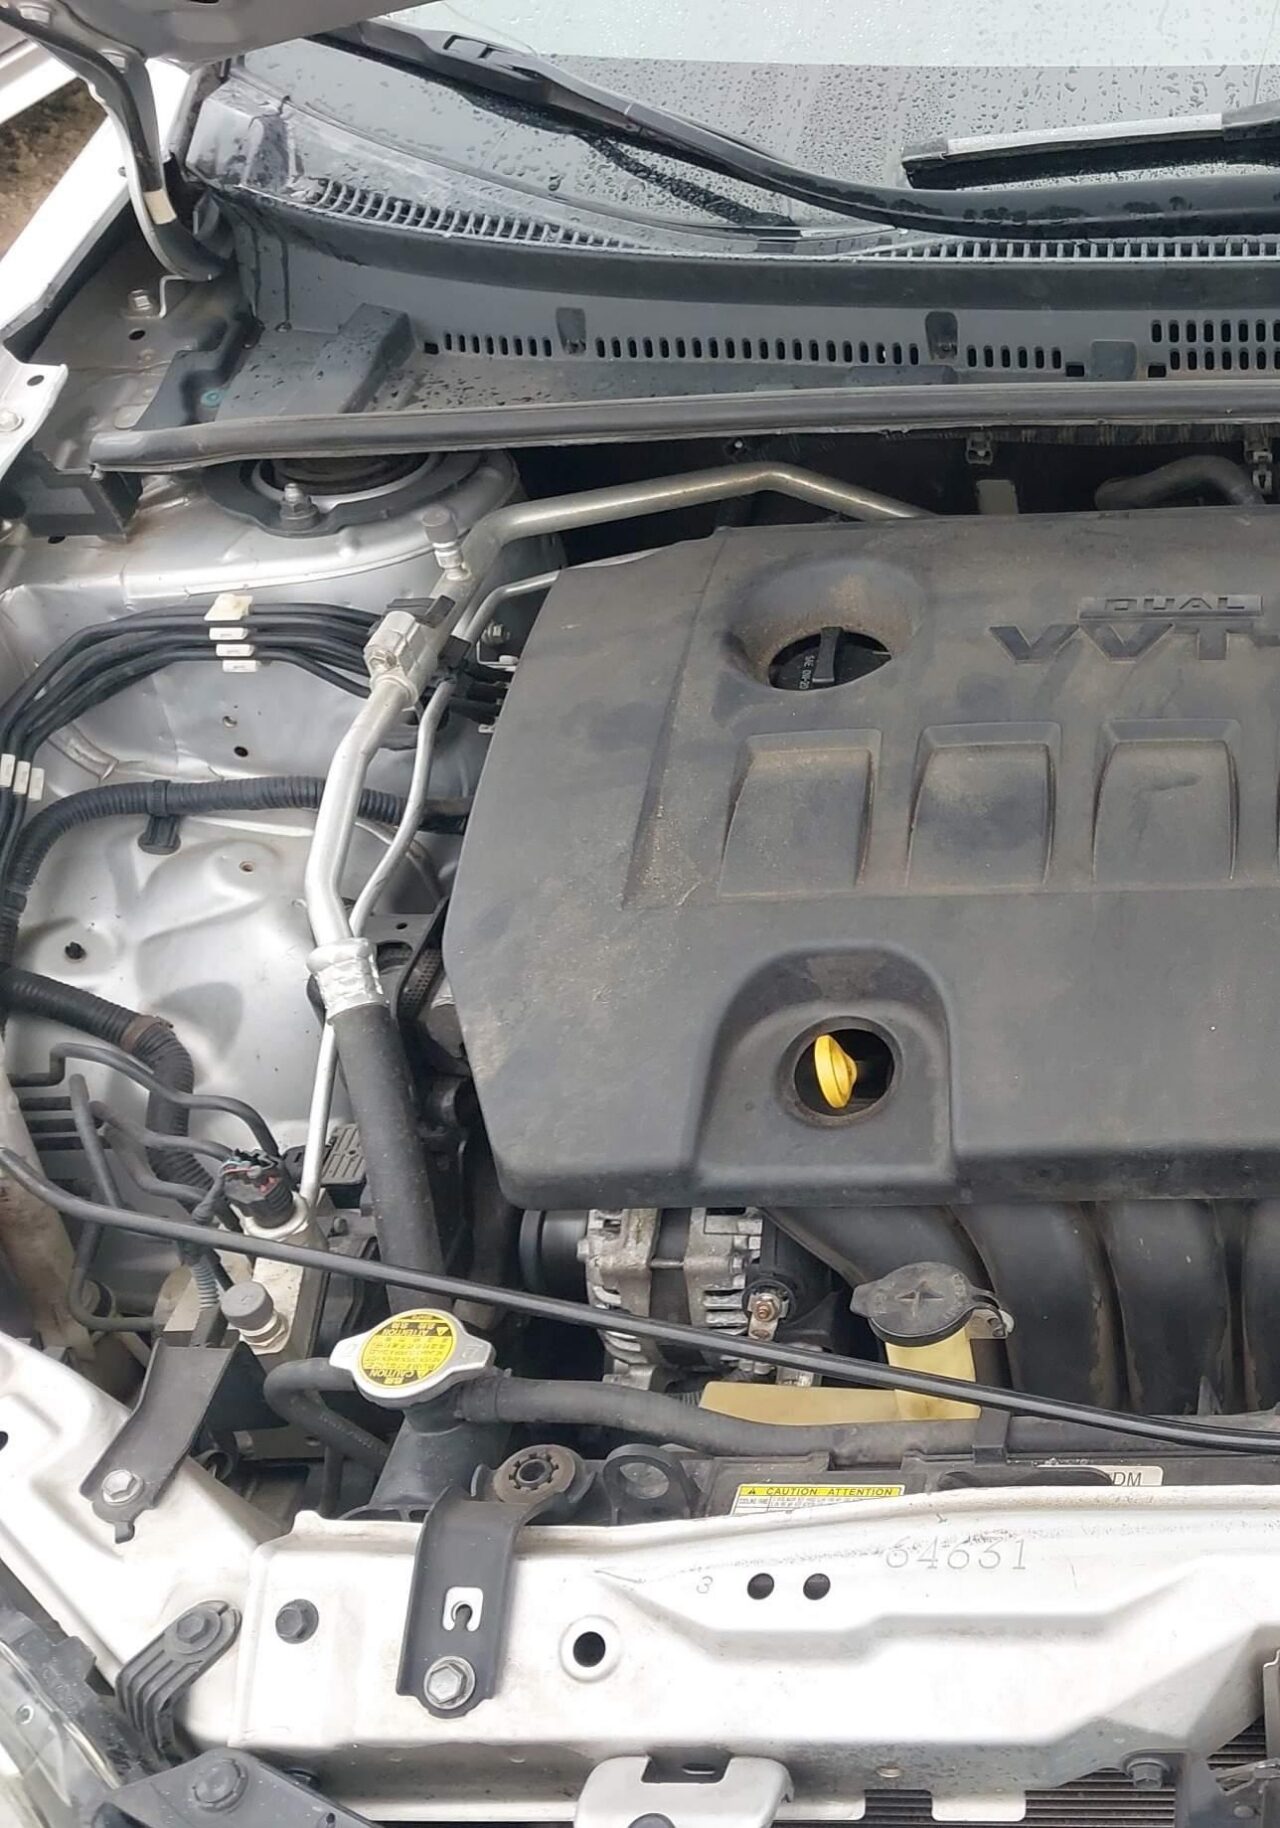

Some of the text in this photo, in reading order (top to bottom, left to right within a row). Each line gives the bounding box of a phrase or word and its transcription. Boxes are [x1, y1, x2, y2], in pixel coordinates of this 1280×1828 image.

[1104, 596, 1246, 611] DUAL
[369, 1369, 415, 1378] CAUTION
[766, 1487, 893, 1497] CAUTION ATTENTION
